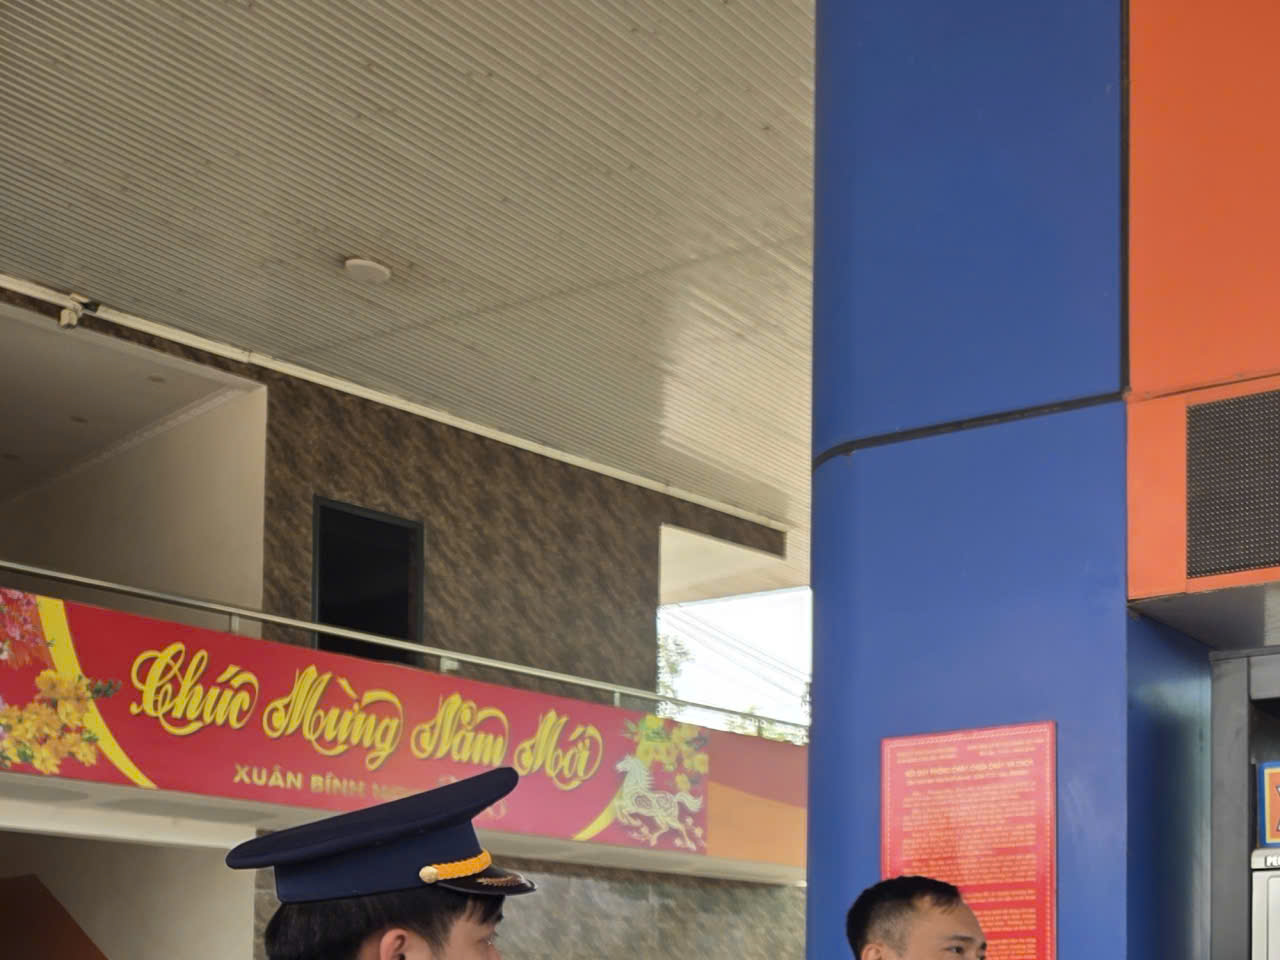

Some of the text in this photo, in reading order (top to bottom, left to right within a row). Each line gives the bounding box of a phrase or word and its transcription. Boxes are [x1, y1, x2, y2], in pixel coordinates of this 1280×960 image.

[130, 641, 604, 791] Chức Mừng Năm Mới
[233, 764, 302, 790] XUÂN
